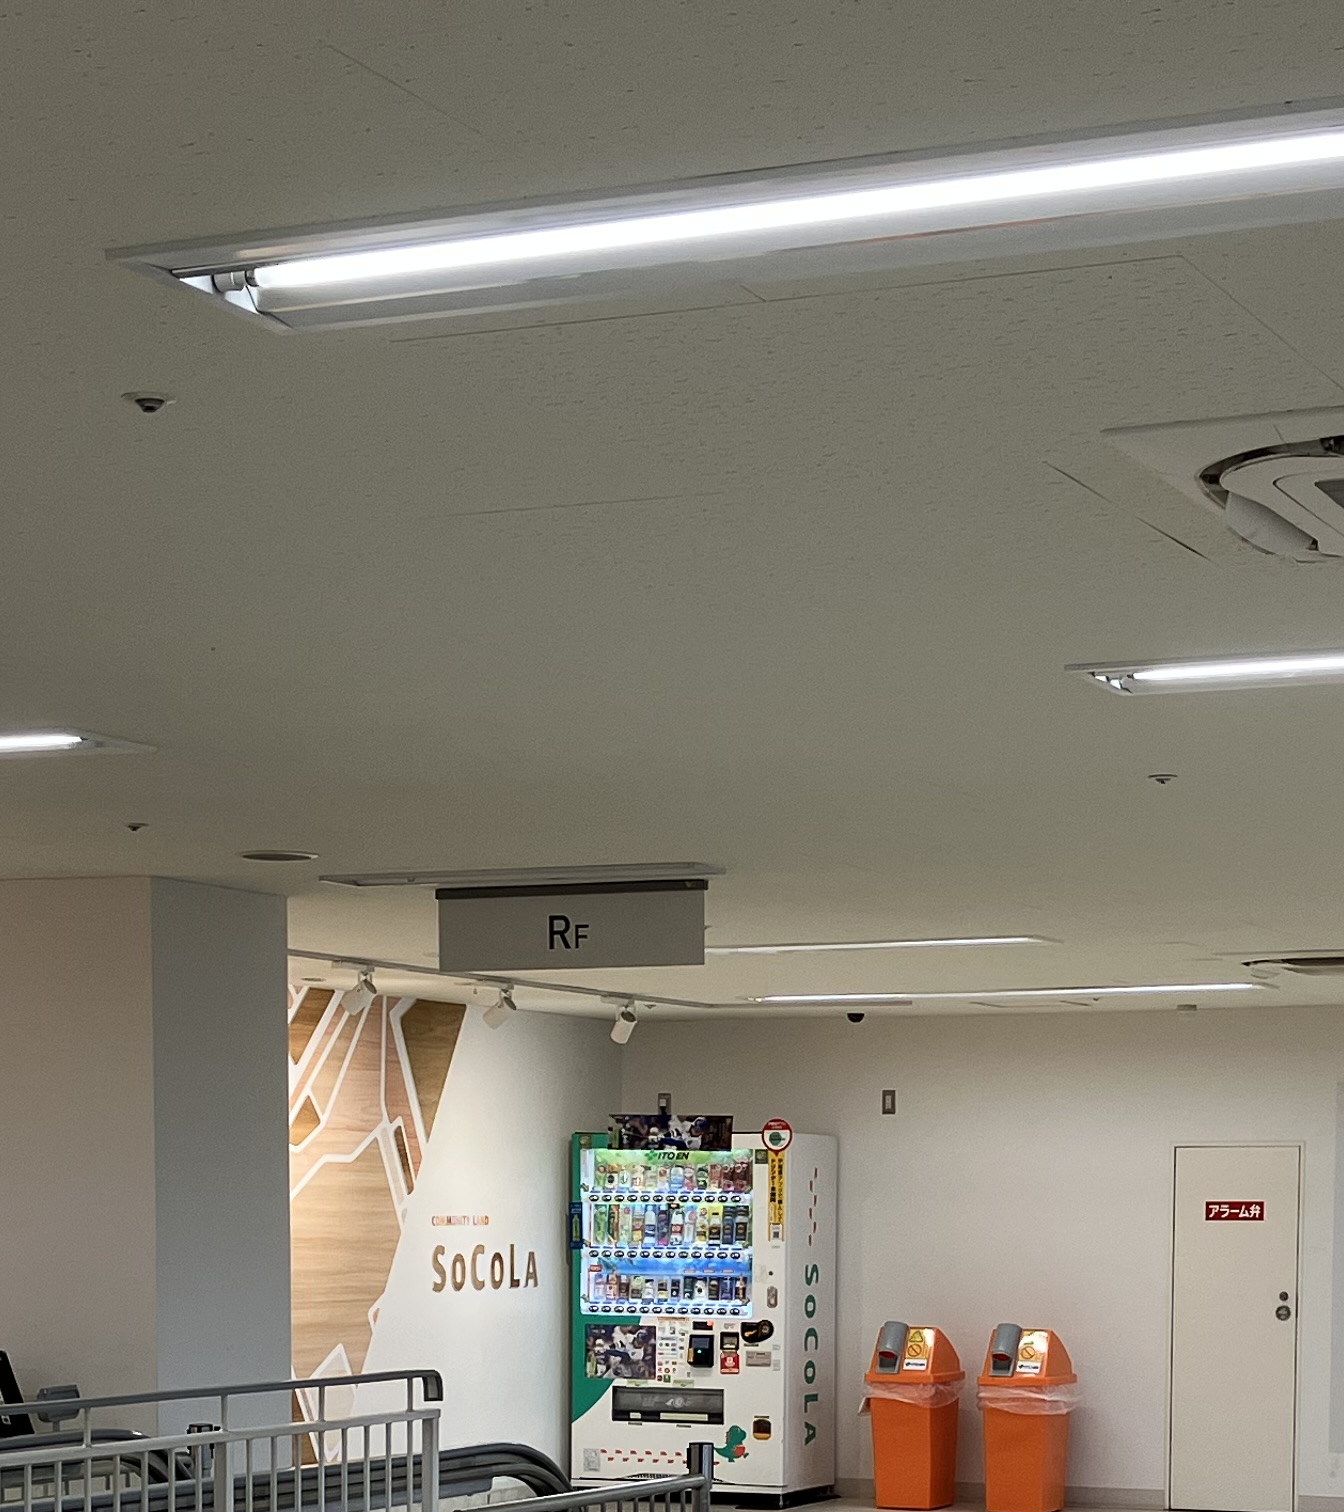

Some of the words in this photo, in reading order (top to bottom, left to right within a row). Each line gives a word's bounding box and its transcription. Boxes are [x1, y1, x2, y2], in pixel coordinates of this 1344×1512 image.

[657, 1152, 674, 1161] ITO
[675, 1152, 690, 1161] EN
[1208, 1204, 1261, 1218] アラーム弁
[804, 1264, 819, 1447] SOCOLA
